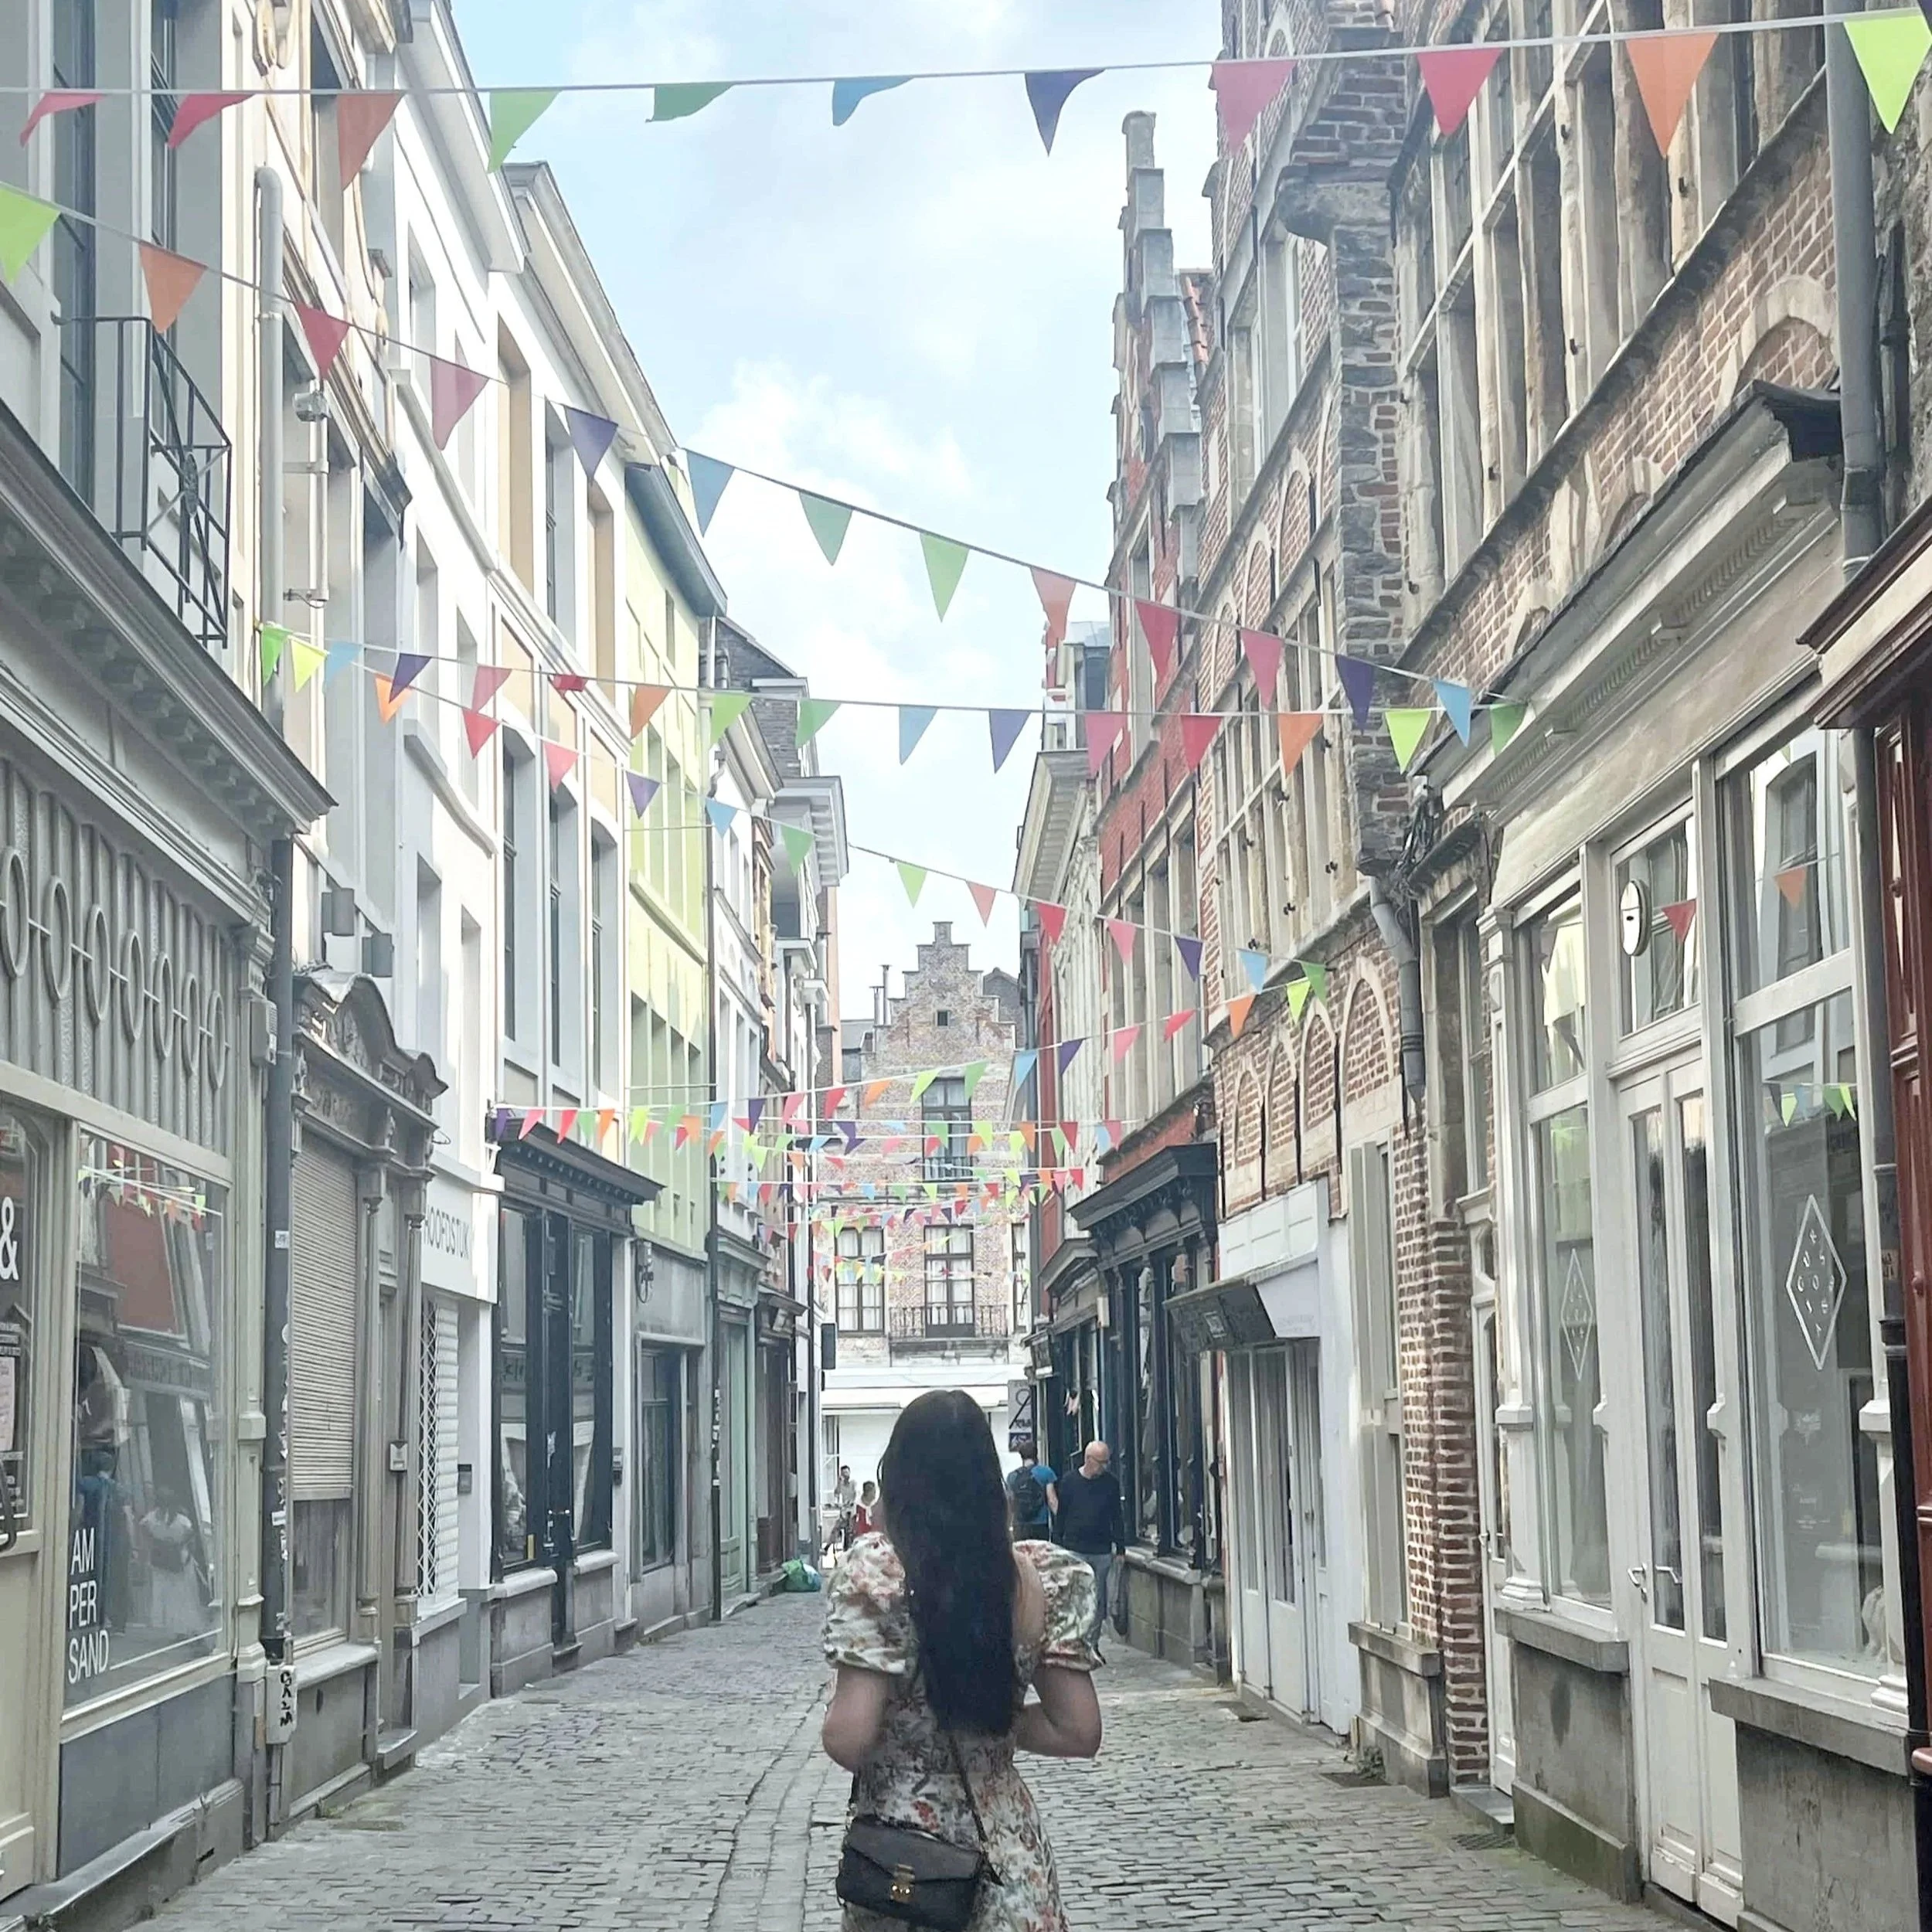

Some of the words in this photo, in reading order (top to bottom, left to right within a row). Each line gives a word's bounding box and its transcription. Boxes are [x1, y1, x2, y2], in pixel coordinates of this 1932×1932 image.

[0, 1196, 19, 1281] &
[70, 1526, 95, 1576] AM
[70, 1580, 97, 1630] PER
[68, 1629, 110, 1685] SAND
